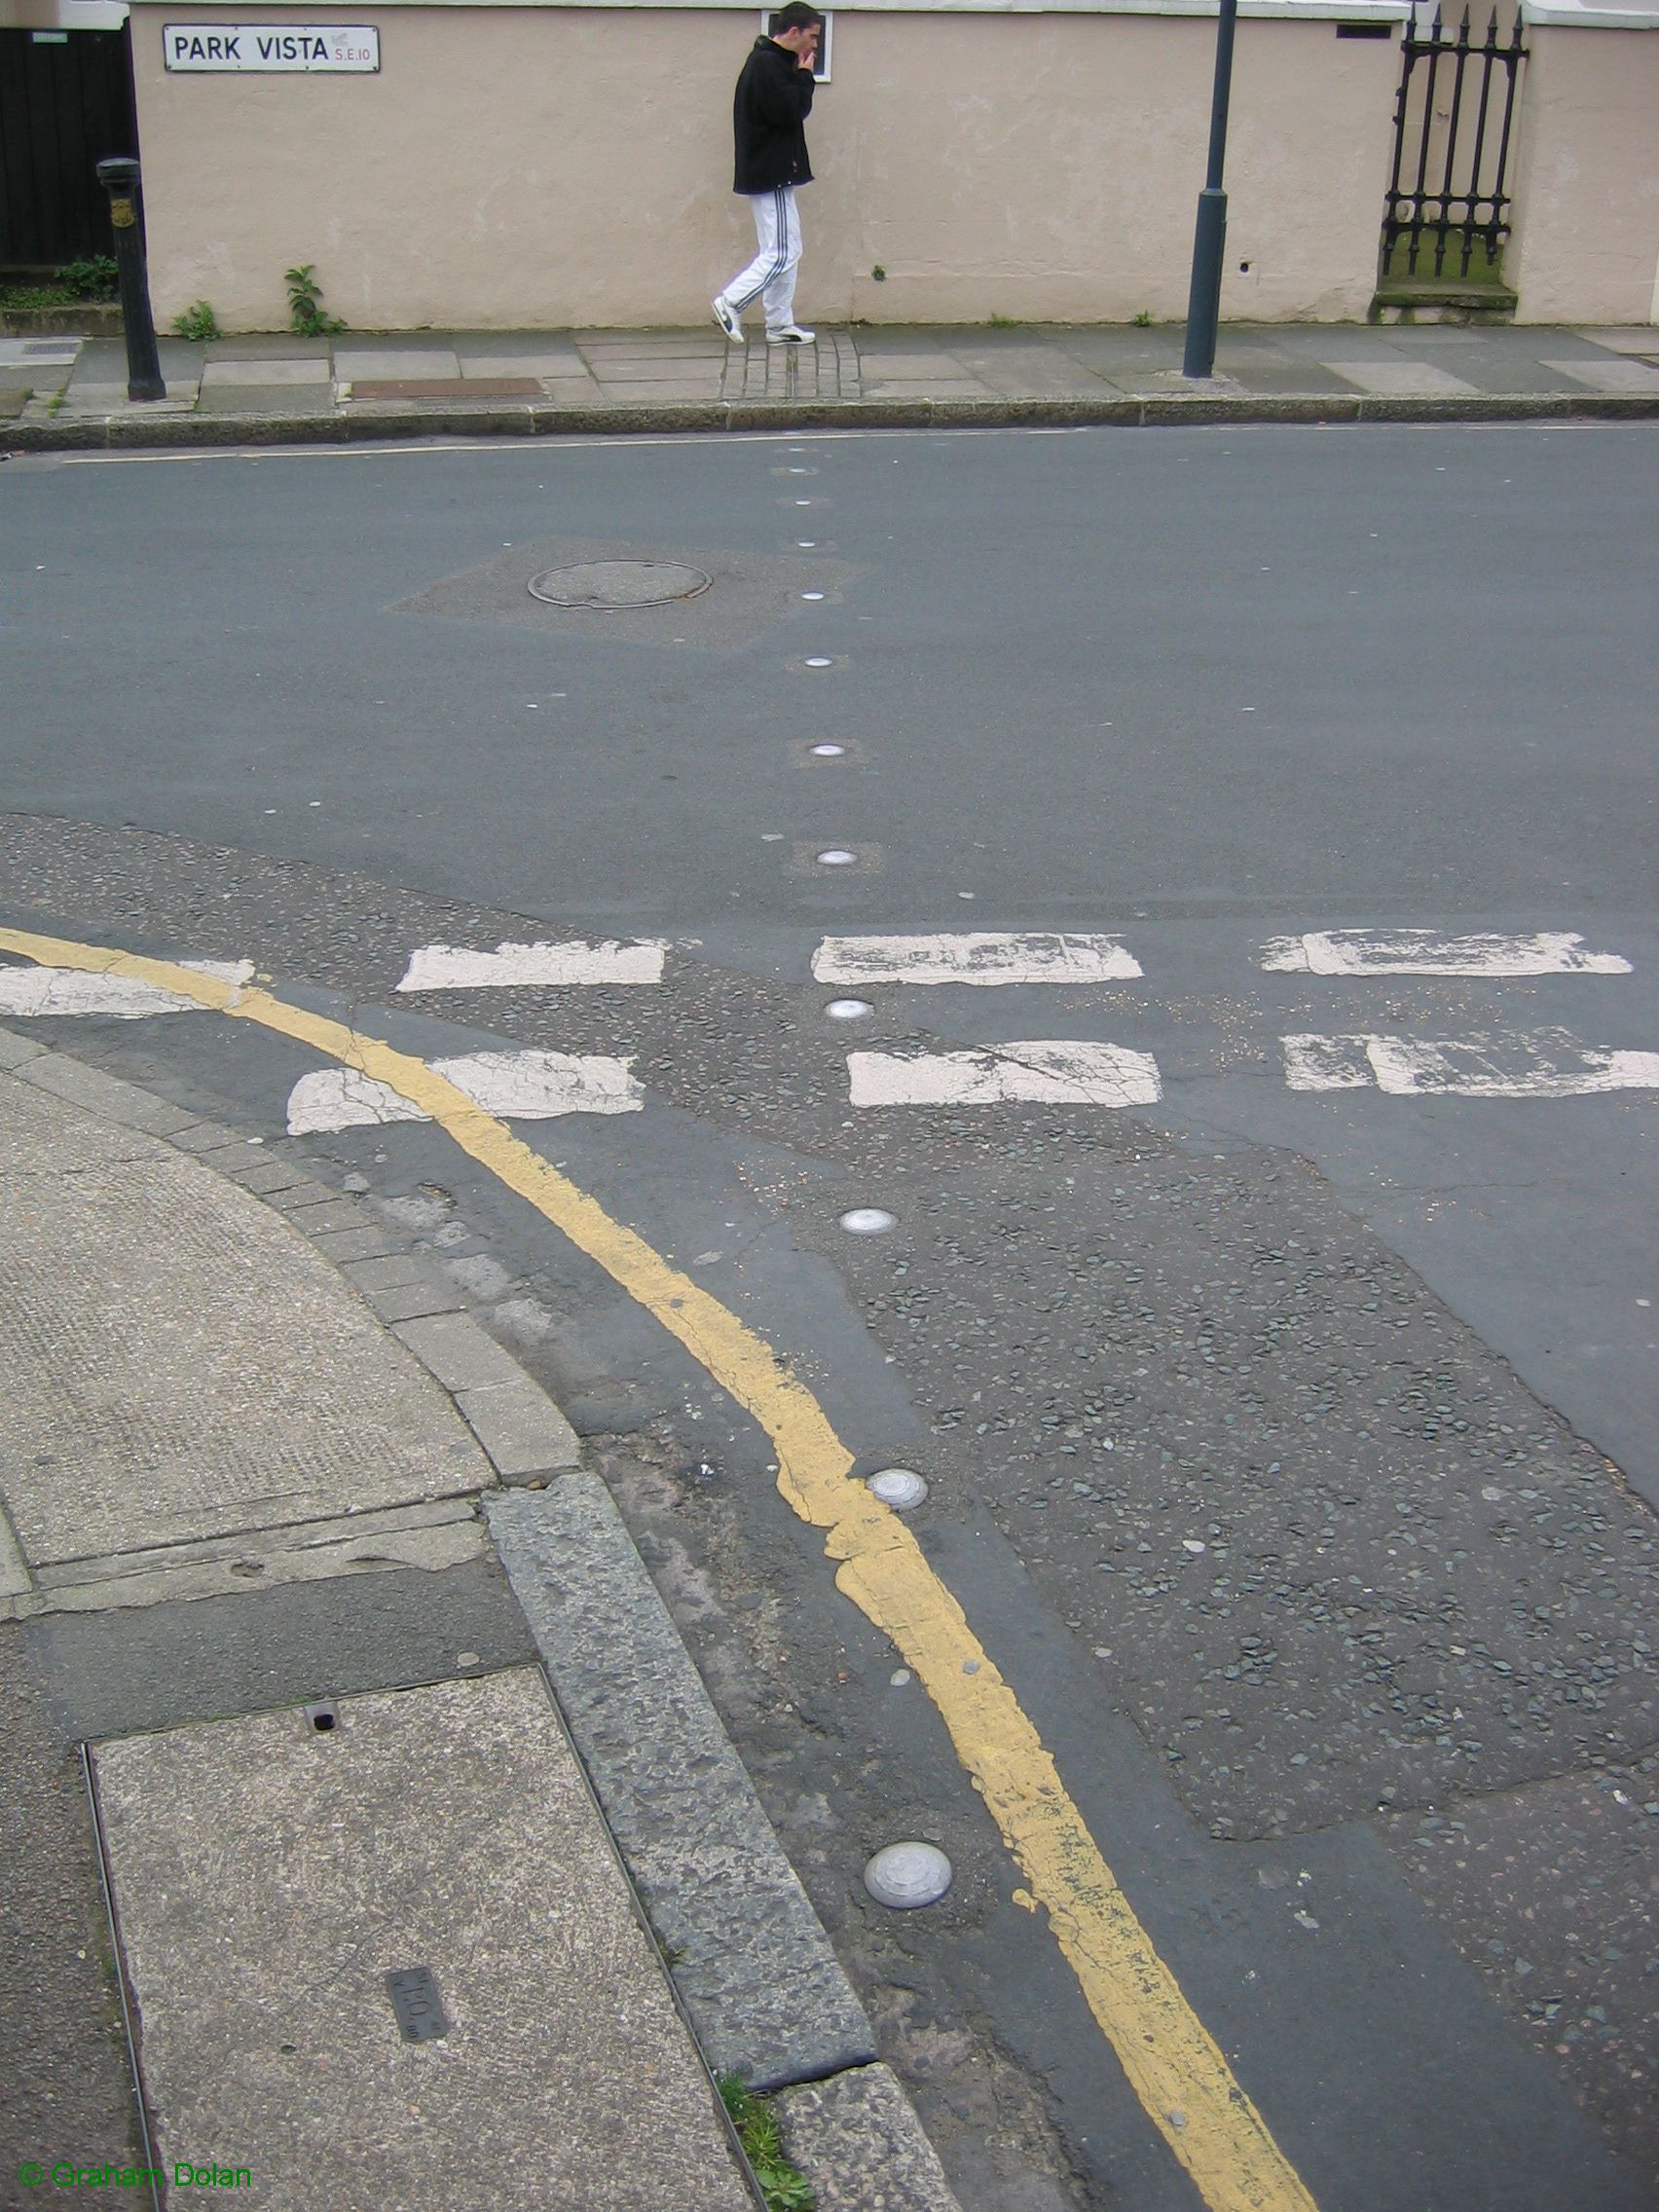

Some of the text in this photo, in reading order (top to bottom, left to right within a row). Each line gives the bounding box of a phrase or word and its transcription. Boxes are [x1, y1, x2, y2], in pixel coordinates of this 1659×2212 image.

[174, 37, 371, 60] PARK VISTA S.E.10
